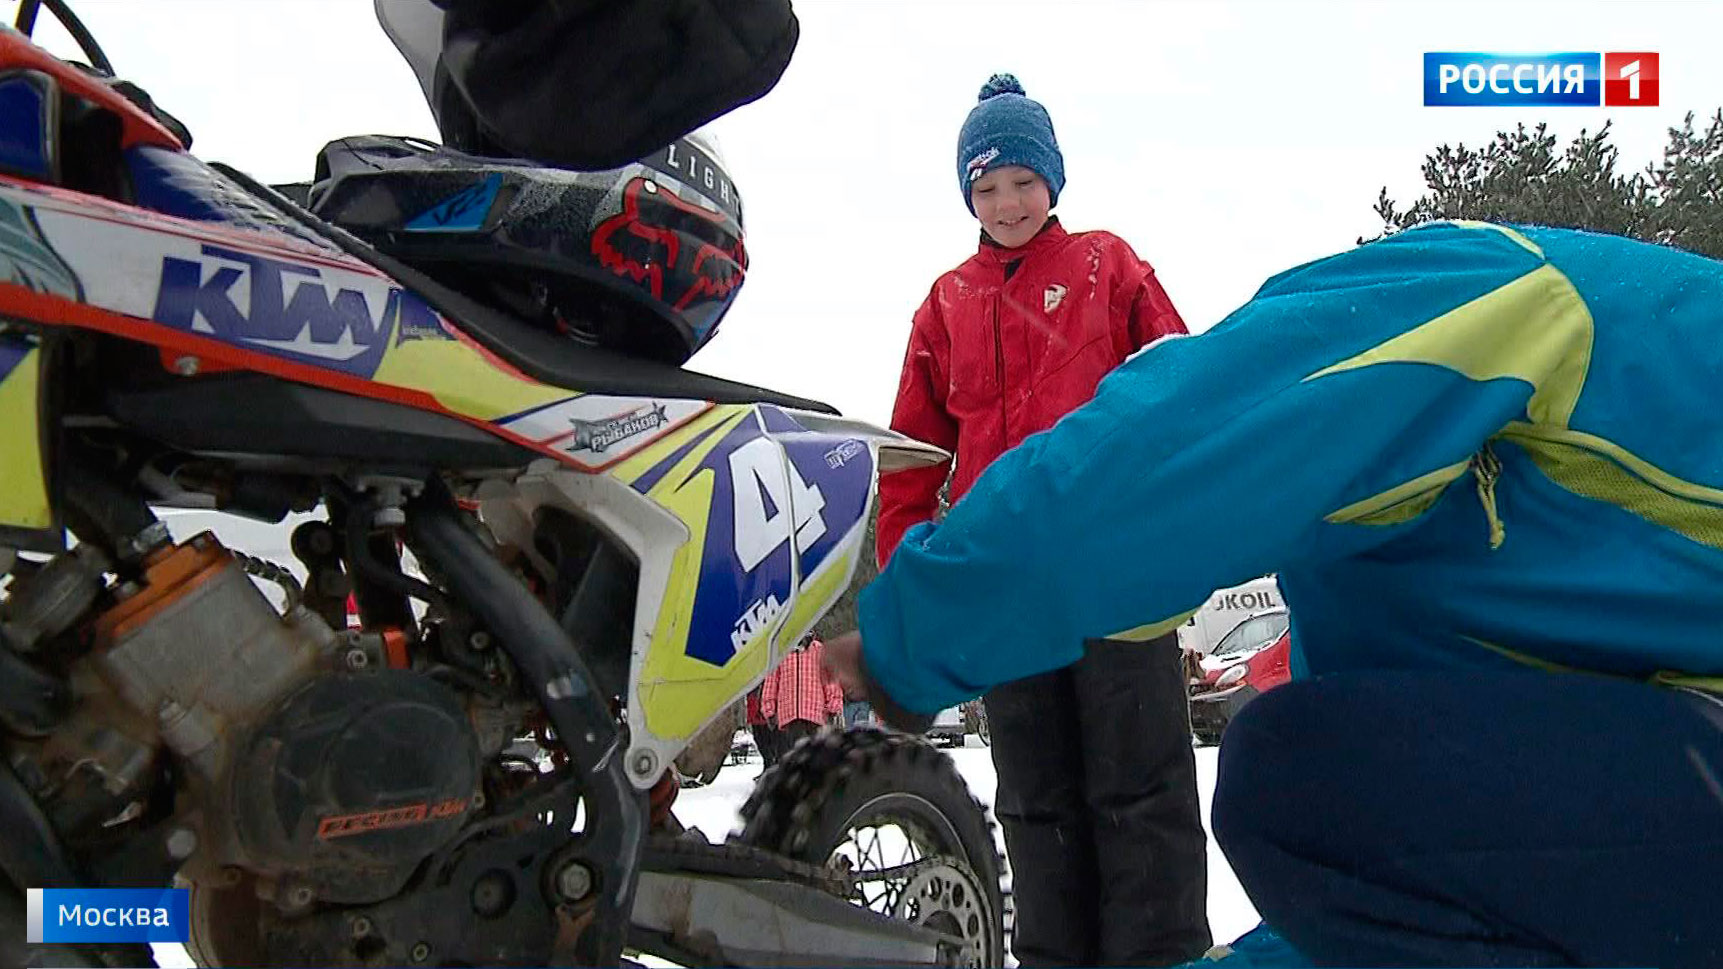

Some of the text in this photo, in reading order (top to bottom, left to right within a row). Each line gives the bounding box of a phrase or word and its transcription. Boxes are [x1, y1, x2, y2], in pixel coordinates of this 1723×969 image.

[152, 243, 386, 354] KTM
[728, 436, 828, 574] 4
[730, 593, 789, 653] KTM
